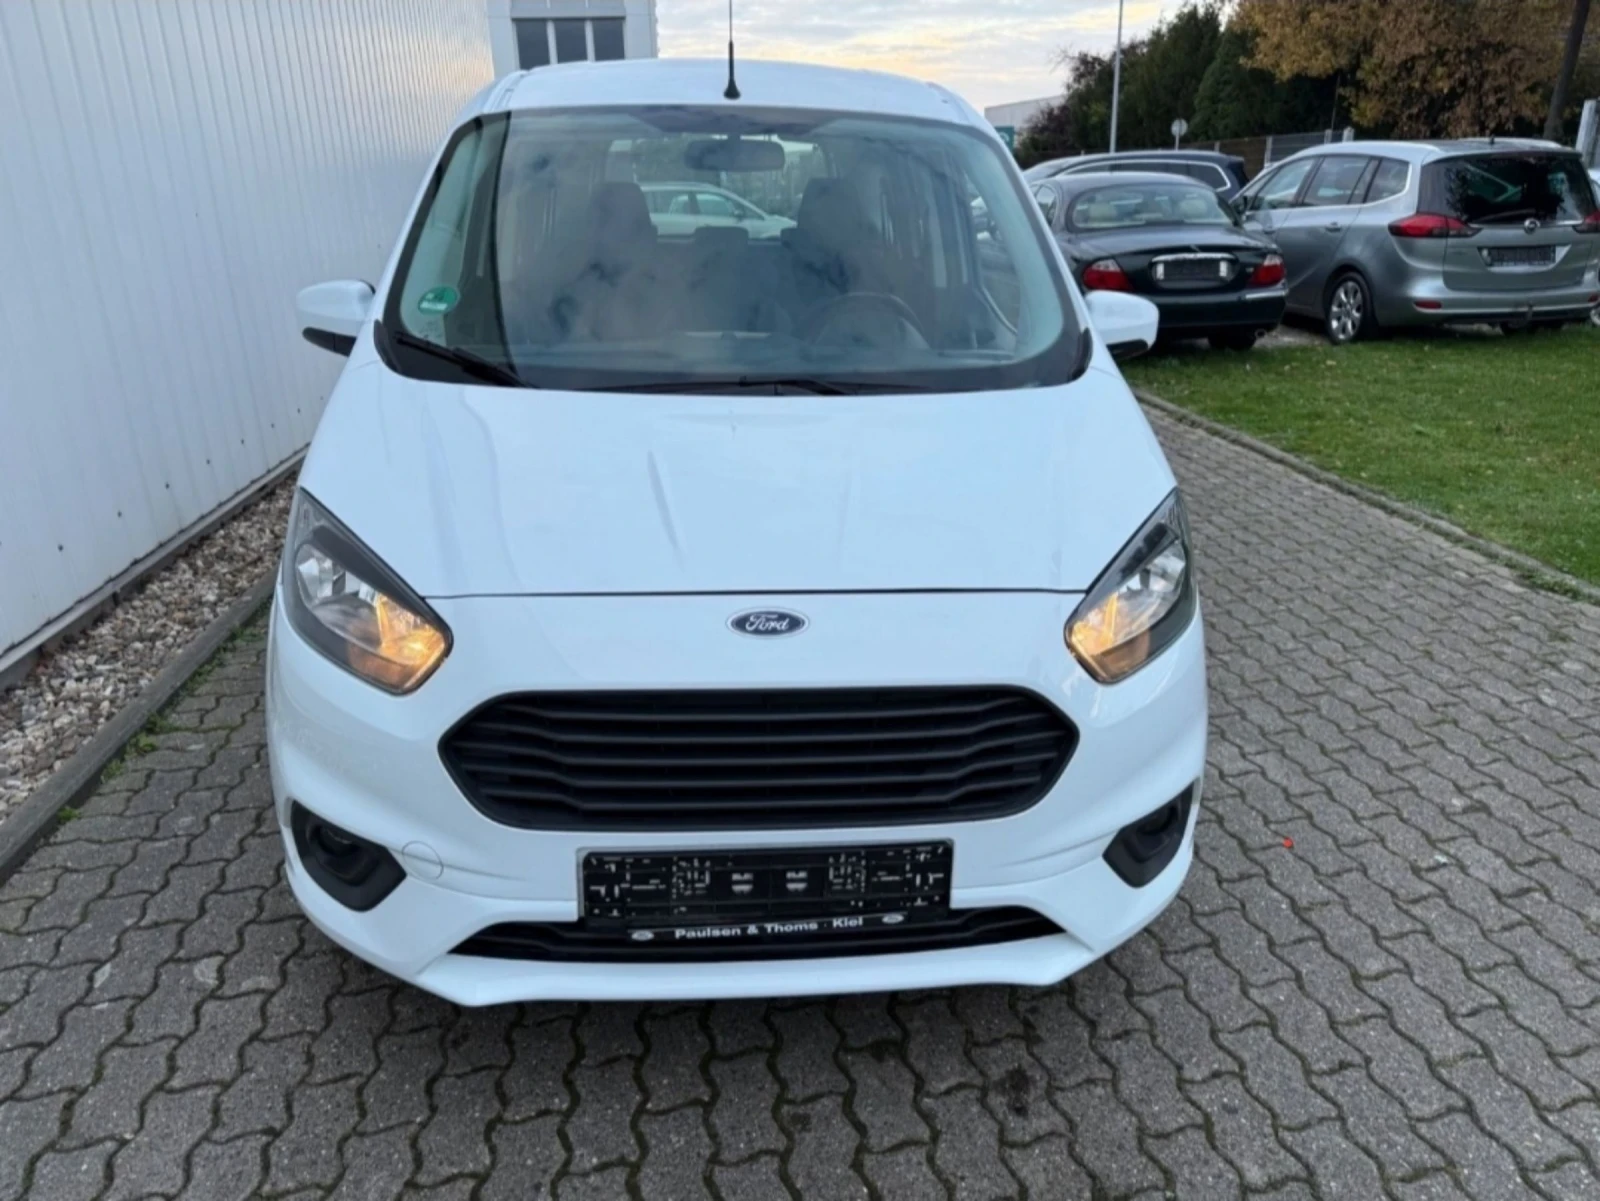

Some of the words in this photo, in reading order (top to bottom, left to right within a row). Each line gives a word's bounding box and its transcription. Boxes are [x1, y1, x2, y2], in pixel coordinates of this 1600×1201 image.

[745, 613, 790, 631] Ford
[674, 927, 741, 939] Paulsen
[747, 924, 759, 935] &
[832, 916, 863, 928] Kiel
